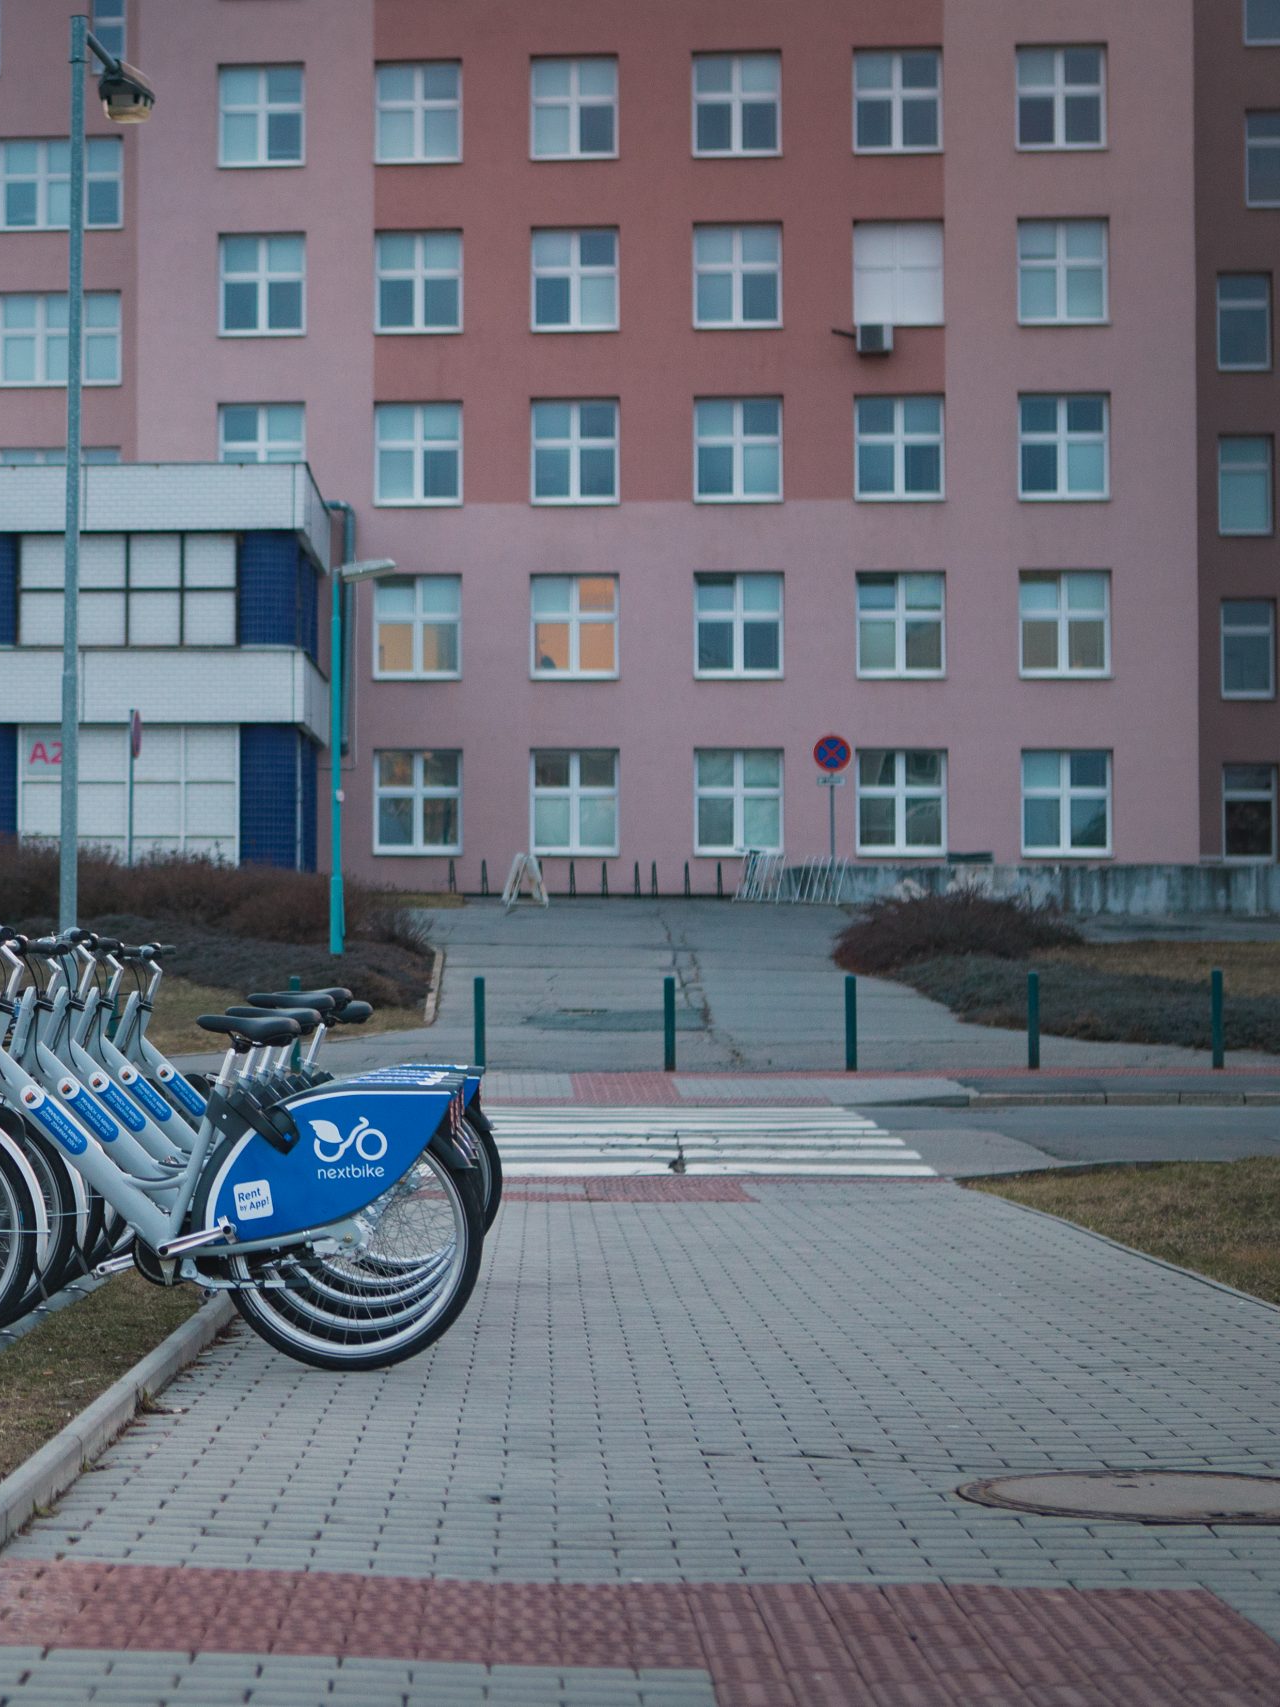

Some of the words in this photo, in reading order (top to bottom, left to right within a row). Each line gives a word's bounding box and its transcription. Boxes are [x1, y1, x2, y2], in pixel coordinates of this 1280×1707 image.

[50, 1120, 69, 1139] ZDARMA
[99, 1118, 113, 1132] MINUT
[66, 1128, 82, 1144] MINUT
[317, 1163, 385, 1180] nextbike
[237, 1187, 261, 1202] Rent
[239, 1204, 248, 1212] by
[249, 1196, 270, 1211] App!
